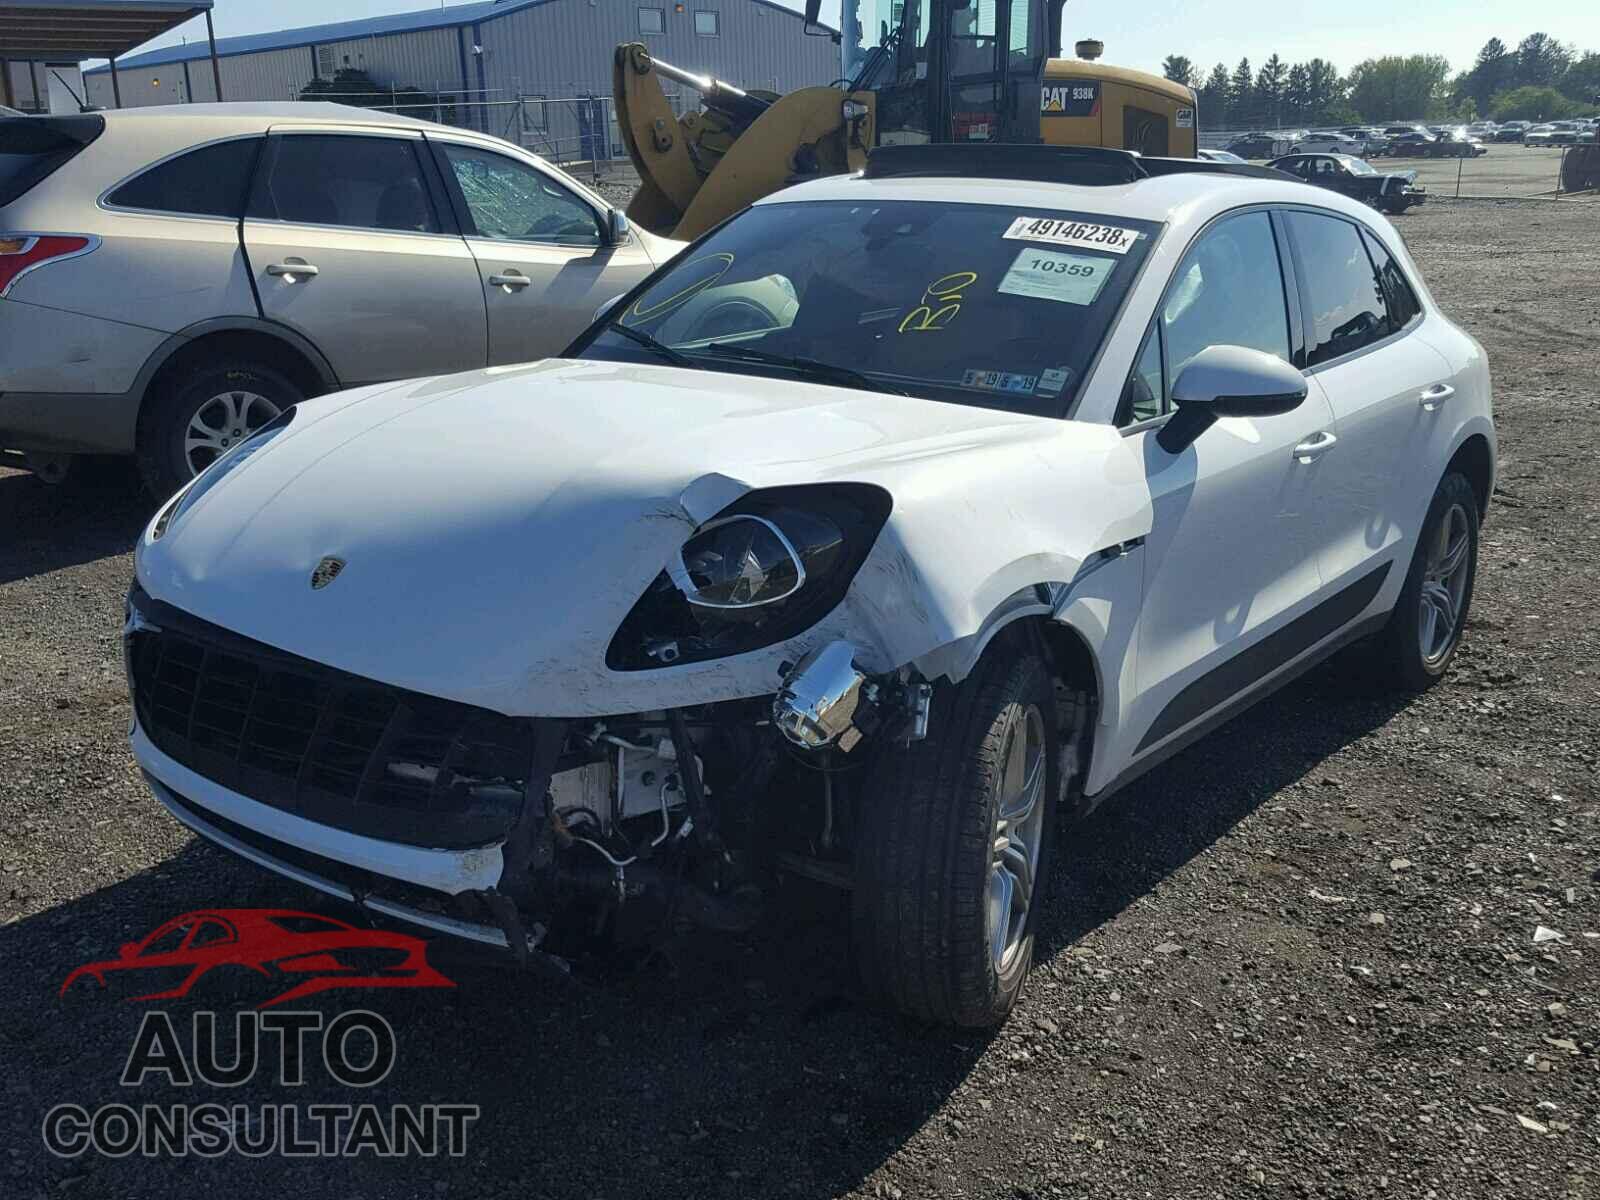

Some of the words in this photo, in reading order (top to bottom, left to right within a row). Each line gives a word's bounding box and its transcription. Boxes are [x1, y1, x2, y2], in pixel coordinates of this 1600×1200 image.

[1041, 87, 1068, 111] CAT
[1073, 88, 1094, 100] 938K
[1031, 259, 1094, 277] 10359
